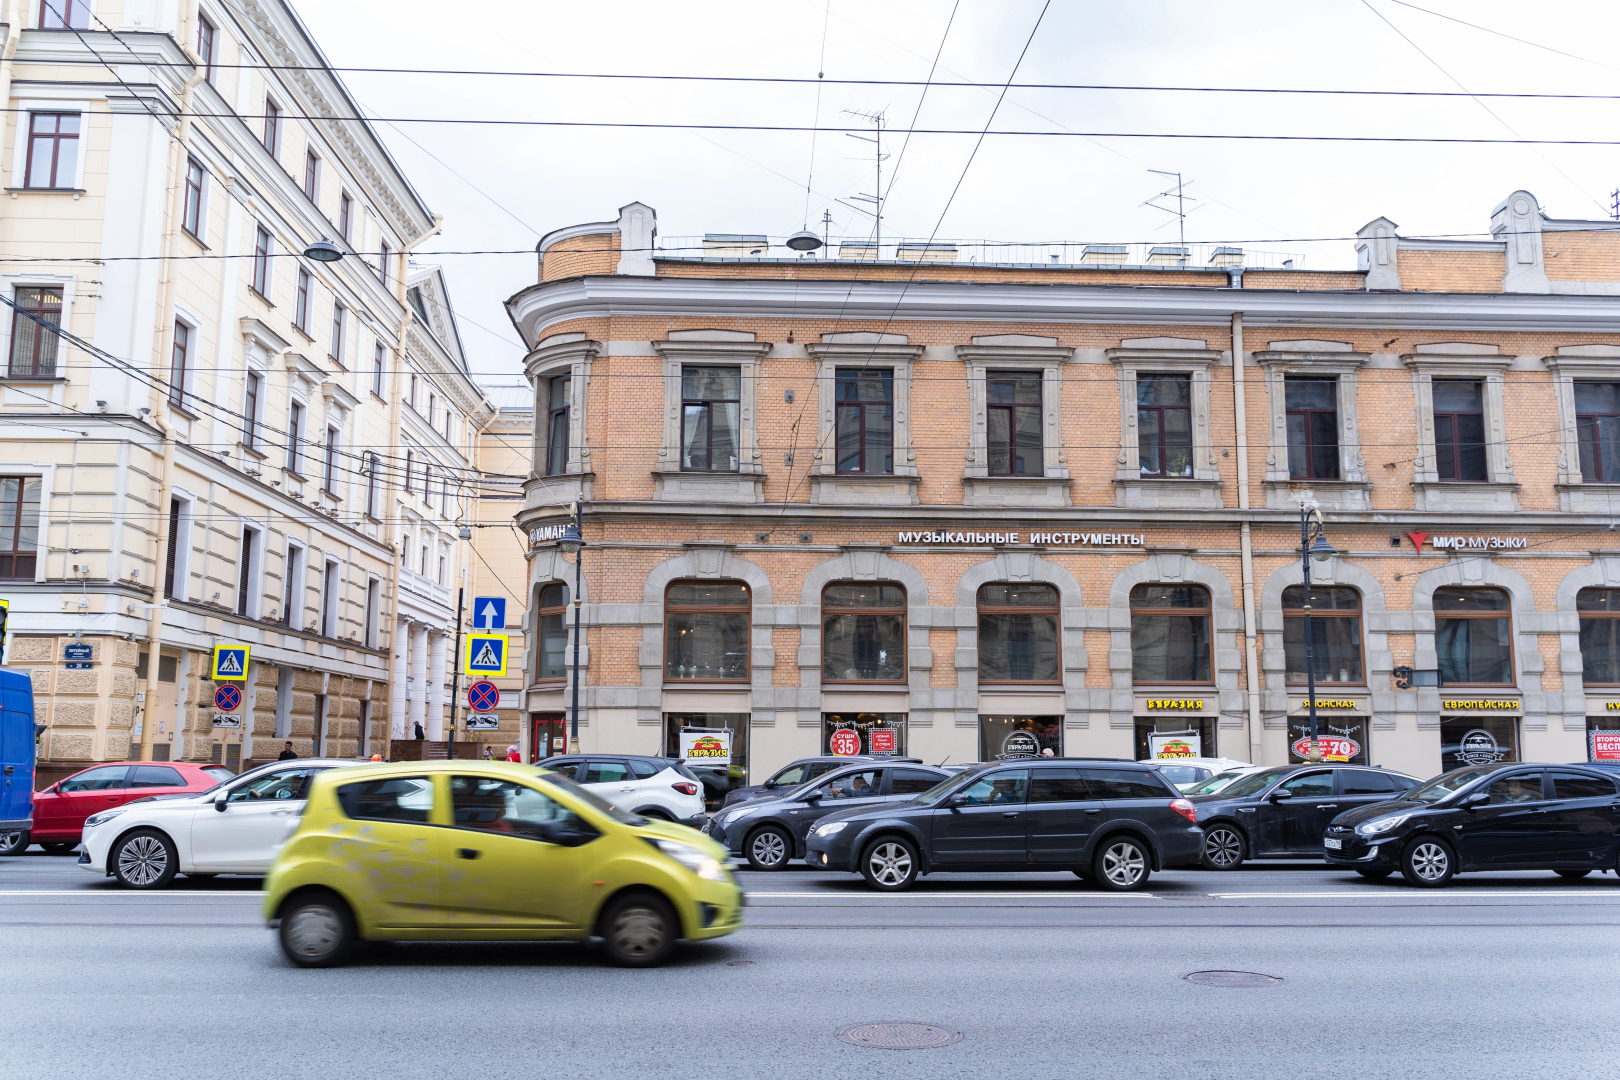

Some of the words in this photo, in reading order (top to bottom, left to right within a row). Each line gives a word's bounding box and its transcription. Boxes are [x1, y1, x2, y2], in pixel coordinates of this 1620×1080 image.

[535, 525, 572, 541] YAMAH
[898, 531, 1019, 544] МУЗЫКАЛЬНЫЕ
[1030, 532, 1144, 545] ИНСТРУМЕНТЫ
[1147, 699, 1203, 709] ЕВРАЗИЯ
[1444, 700, 1519, 709] ЕВРОПЕЙСКАЯ
[1608, 702, 1620, 710] КУ
[837, 739, 854, 754] 35
[687, 748, 728, 758] ЕВРАЗИЯ
